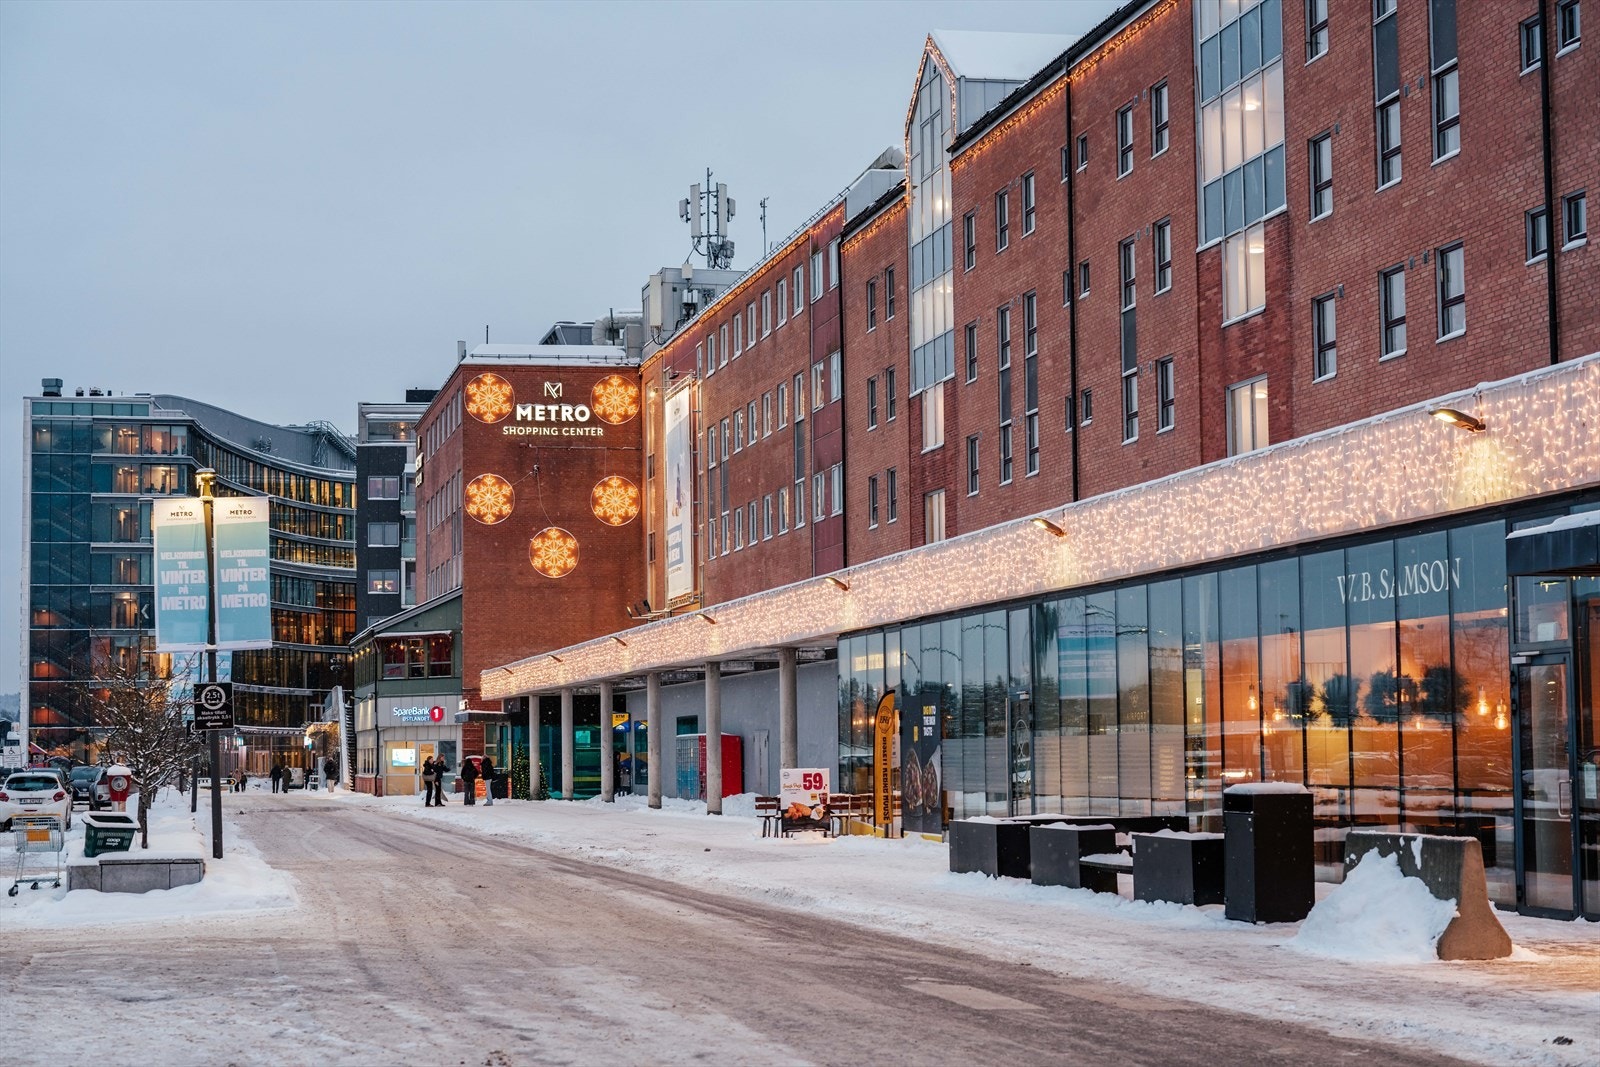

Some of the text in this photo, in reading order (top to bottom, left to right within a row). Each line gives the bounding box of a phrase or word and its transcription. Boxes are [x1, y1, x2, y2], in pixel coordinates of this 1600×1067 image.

[516, 404, 591, 422] METRO
[503, 427, 604, 436] SHOPPING CENTER
[220, 549, 267, 558] VELKOMMEN
[177, 561, 189, 569] TIL
[237, 559, 248, 567] TIL
[161, 570, 206, 584] VINTER
[220, 568, 267, 582] VINTER
[1380, 558, 1461, 599] SAMSON
[178, 585, 189, 594] PÅ
[238, 582, 248, 592] PÅ
[161, 596, 206, 610] METRO
[221, 593, 268, 608] METRO
[393, 706, 430, 717] SpareBank
[882, 795, 890, 821] HOUSE
